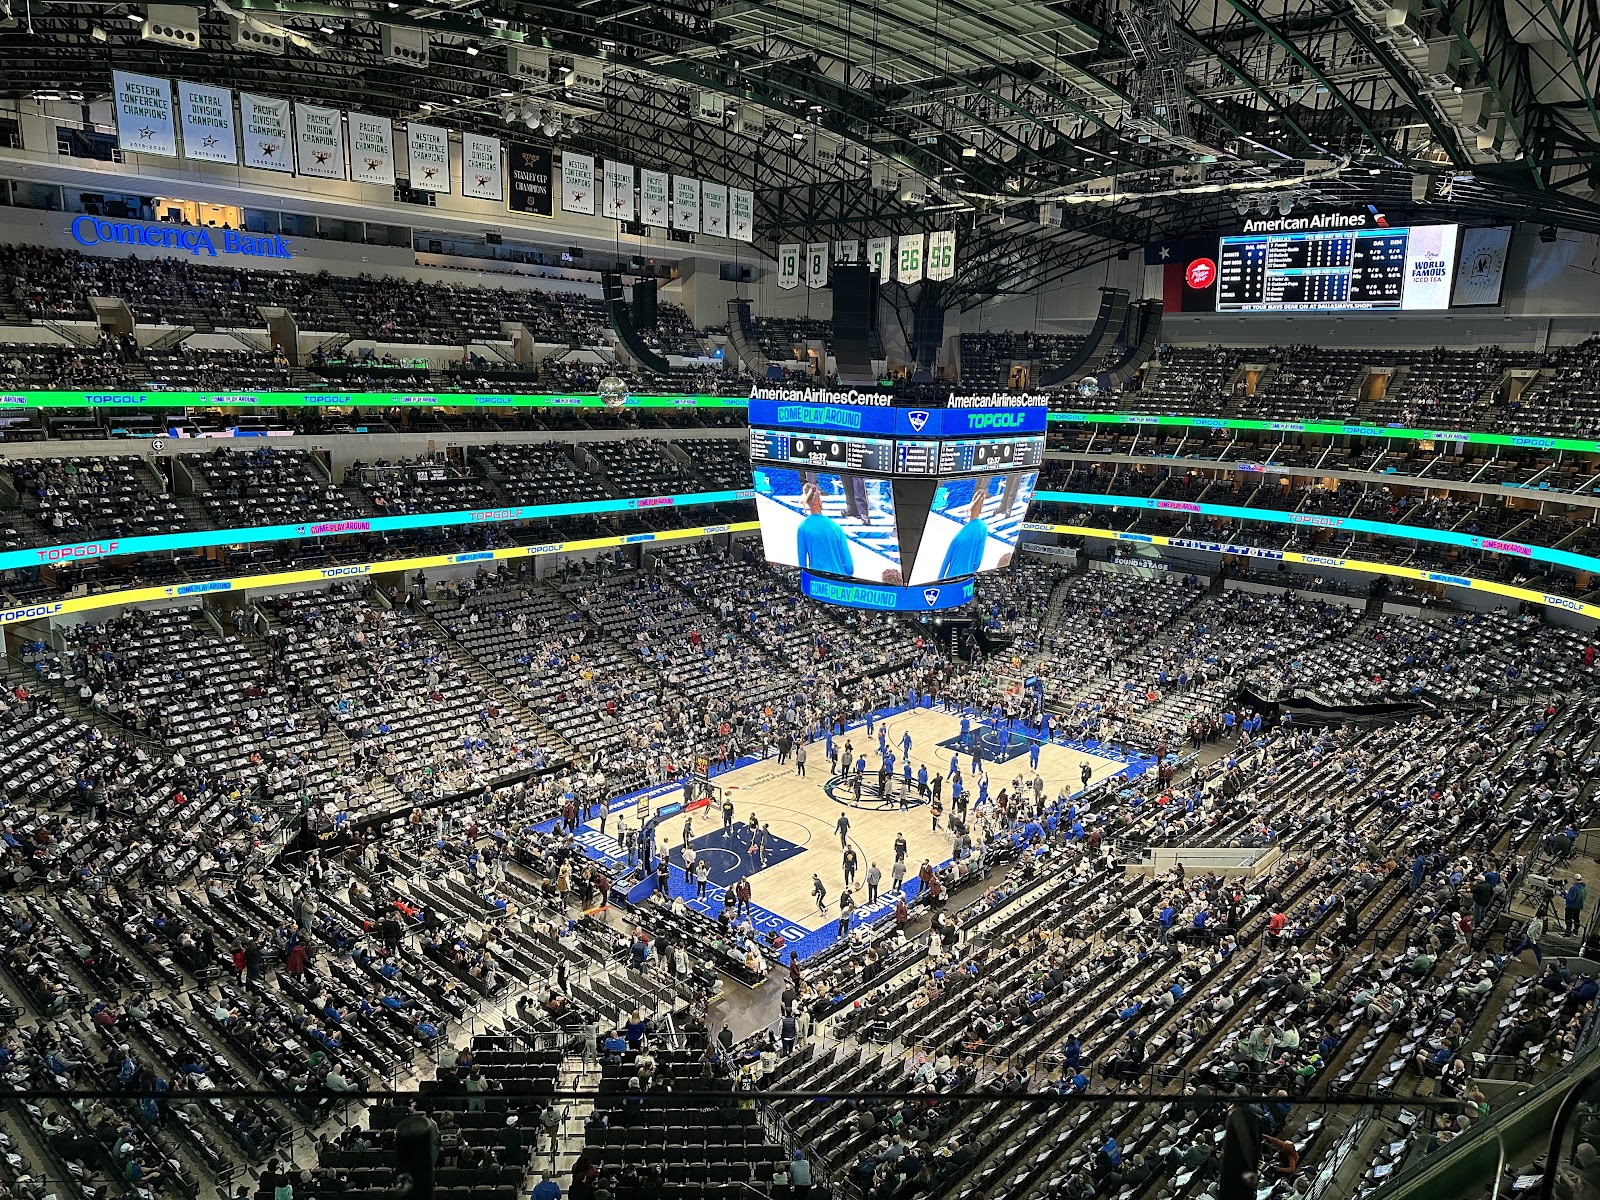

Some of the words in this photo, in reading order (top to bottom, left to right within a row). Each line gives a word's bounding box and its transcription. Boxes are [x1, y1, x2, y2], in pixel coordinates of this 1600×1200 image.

[125, 82, 160, 97] WESTERN
[120, 92, 168, 109] CONFERENCE
[189, 93, 222, 107] CENTRAL
[123, 105, 167, 120] CHAMPIONS
[192, 104, 222, 117] DIVISION
[253, 104, 279, 117] PACIFIC
[188, 114, 228, 129] CHAMPIONS
[252, 115, 281, 128] DIVISION
[306, 114, 331, 126] PACIFIC
[248, 125, 286, 139] CHAMPIONS
[306, 124, 333, 136] DIVISION
[359, 122, 382, 134] PACIFIC
[302, 134, 338, 147] CHAMPIONS
[359, 132, 384, 144] DIVISION
[415, 132, 440, 144] WESTERN
[355, 142, 388, 154] CHAMPIONS
[411, 141, 445, 153] CONFERENCE
[472, 142, 492, 153] PACIFIC
[413, 150, 444, 163] CHAMPIONS
[472, 151, 493, 162] DIVISION
[468, 160, 497, 171] CHAMPIONS
[568, 160, 588, 170] WESTERN
[513, 170, 536, 183] STANLEY
[536, 173, 548, 184] CUP
[564, 168, 592, 179] CONFERENCE
[566, 177, 591, 188] CHAMPIONS
[611, 180, 627, 190] TROPHY
[646, 176, 662, 186] PACIFIC
[515, 182, 547, 195] CHAMPIONS
[646, 184, 663, 194] DIVISION
[678, 183, 695, 193] CENTRAL
[643, 192, 666, 203] CHAMPIONS
[679, 190, 695, 200] DIVISION
[734, 194, 749, 204] CENTRAL
[676, 197, 697, 208] CHAMPIONS
[734, 202, 749, 211] DIVISION
[732, 209, 751, 219] CHAMPIONS
[1243, 217, 1309, 233] American
[1309, 213, 1366, 228] Airlines
[222, 229, 293, 260] Bank
[901, 249, 919, 271] 26
[930, 246, 951, 269] 56
[782, 256, 795, 276] 19
[813, 254, 821, 275] 8
[1415, 261, 1445, 270] WORLD
[1411, 268, 1446, 277] FAMOUS
[4, 395, 27, 404] AROUND
[85, 395, 147, 404] TOPGOLF
[303, 395, 351, 403] TOPGOLF
[778, 408, 801, 421] COME
[804, 409, 824, 422] PLAY
[825, 409, 860, 427] AROUND
[968, 412, 1025, 429] TOPGOLF
[1052, 413, 1088, 421] TOPGOLF
[1192, 418, 1228, 426] TOPGOLF
[1342, 427, 1385, 436] TOPGOLF
[796, 440, 804, 453] 0
[1511, 437, 1557, 447] TOPGOLF
[831, 443, 839, 456] 0
[978, 447, 985, 460] 0
[1003, 445, 1011, 457] 0
[735, 491, 755, 499] TOPG
[469, 510, 523, 521] TOPGOLF
[1288, 513, 1344, 527] TOPGOLF
[310, 524, 329, 534] COME
[330, 523, 345, 533] PLAY
[345, 521, 370, 531] AROUND
[703, 525, 731, 534] TOPGOLF
[37, 542, 119, 561] TOPGOLF
[526, 544, 563, 554] TOPGOLF
[1481, 540, 1497, 549] COME
[1497, 541, 1510, 551] PLAY
[1510, 543, 1532, 556] AROUND
[1114, 557, 1138, 567] SOUND
[1301, 555, 1345, 567] TOPGOLF
[321, 566, 371, 578] TOPGOLF
[177, 586, 193, 595] COME
[193, 584, 208, 593] PLAY
[209, 582, 231, 591] AROUND
[810, 582, 829, 595] COME
[830, 588, 851, 601] PLAY
[853, 588, 896, 606] AROUND
[1543, 595, 1584, 612] TOPGOLF
[0, 604, 62, 621] TOPGOLF
[696, 765, 707, 773] 24
[700, 887, 784, 928] shiey
